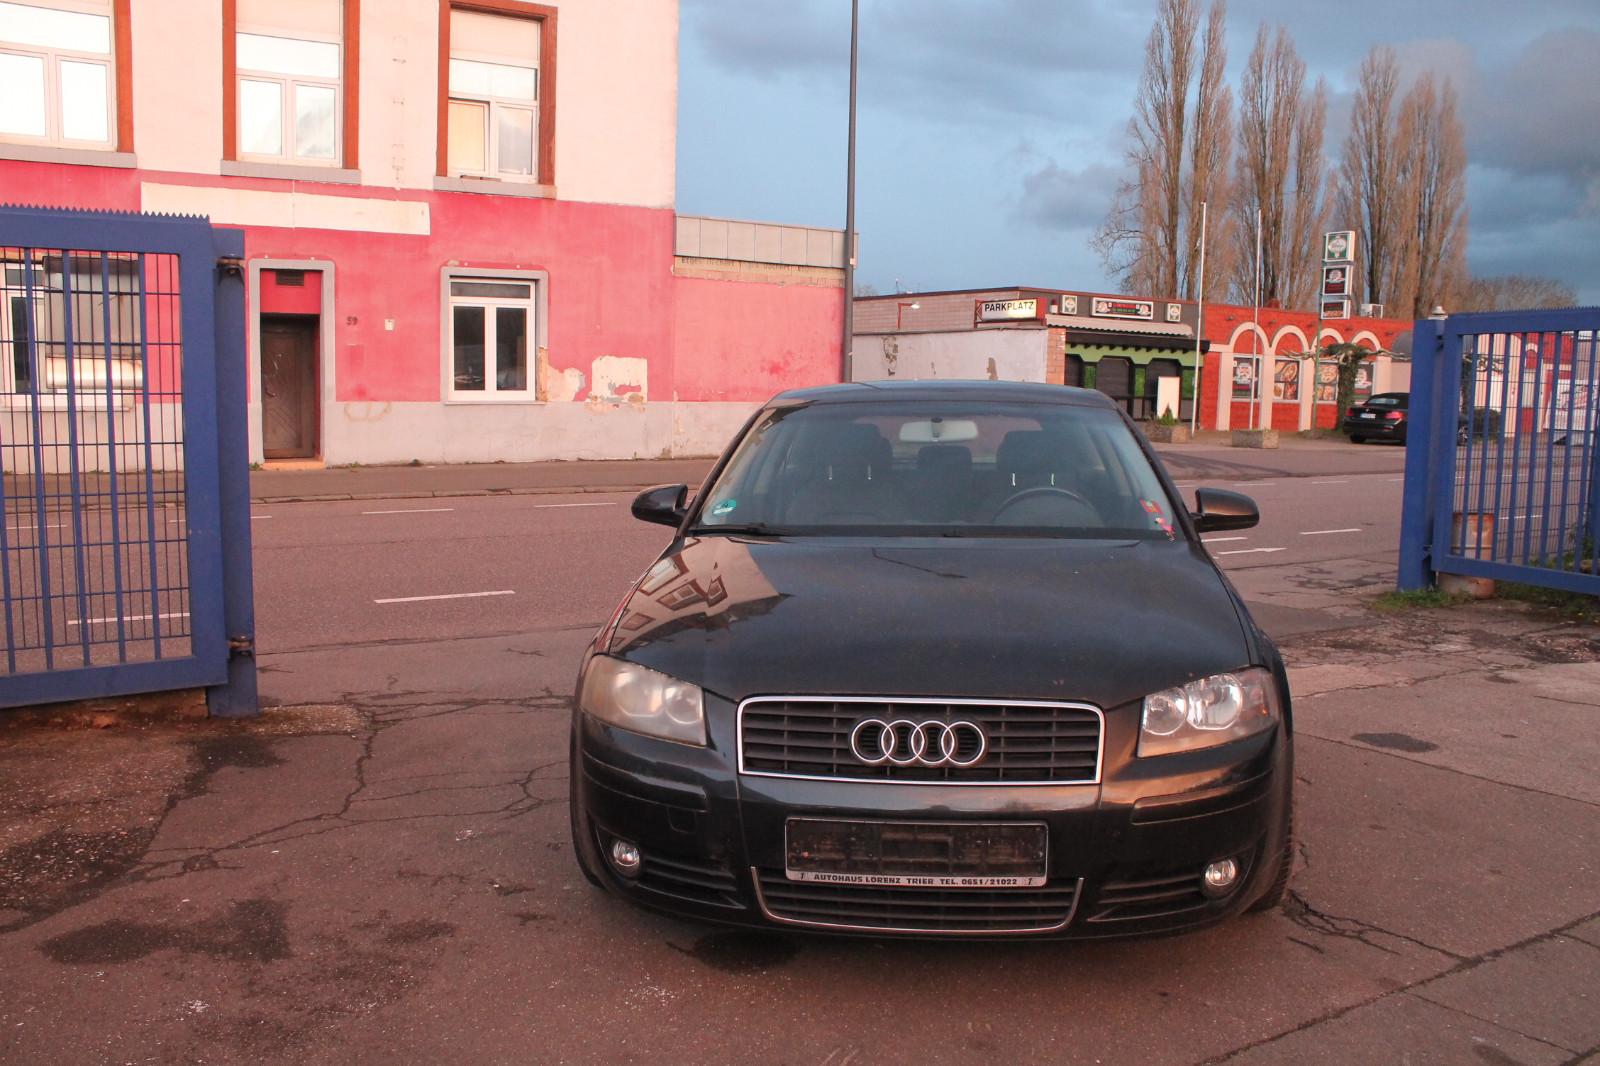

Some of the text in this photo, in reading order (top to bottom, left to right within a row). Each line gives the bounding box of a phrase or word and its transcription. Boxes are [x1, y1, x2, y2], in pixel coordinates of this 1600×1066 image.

[984, 301, 1034, 312] PARKPLATZ
[814, 873, 863, 883] AUTOHAUS
[865, 876, 901, 884] LORENZ
[961, 878, 1018, 886] 0651/21022
